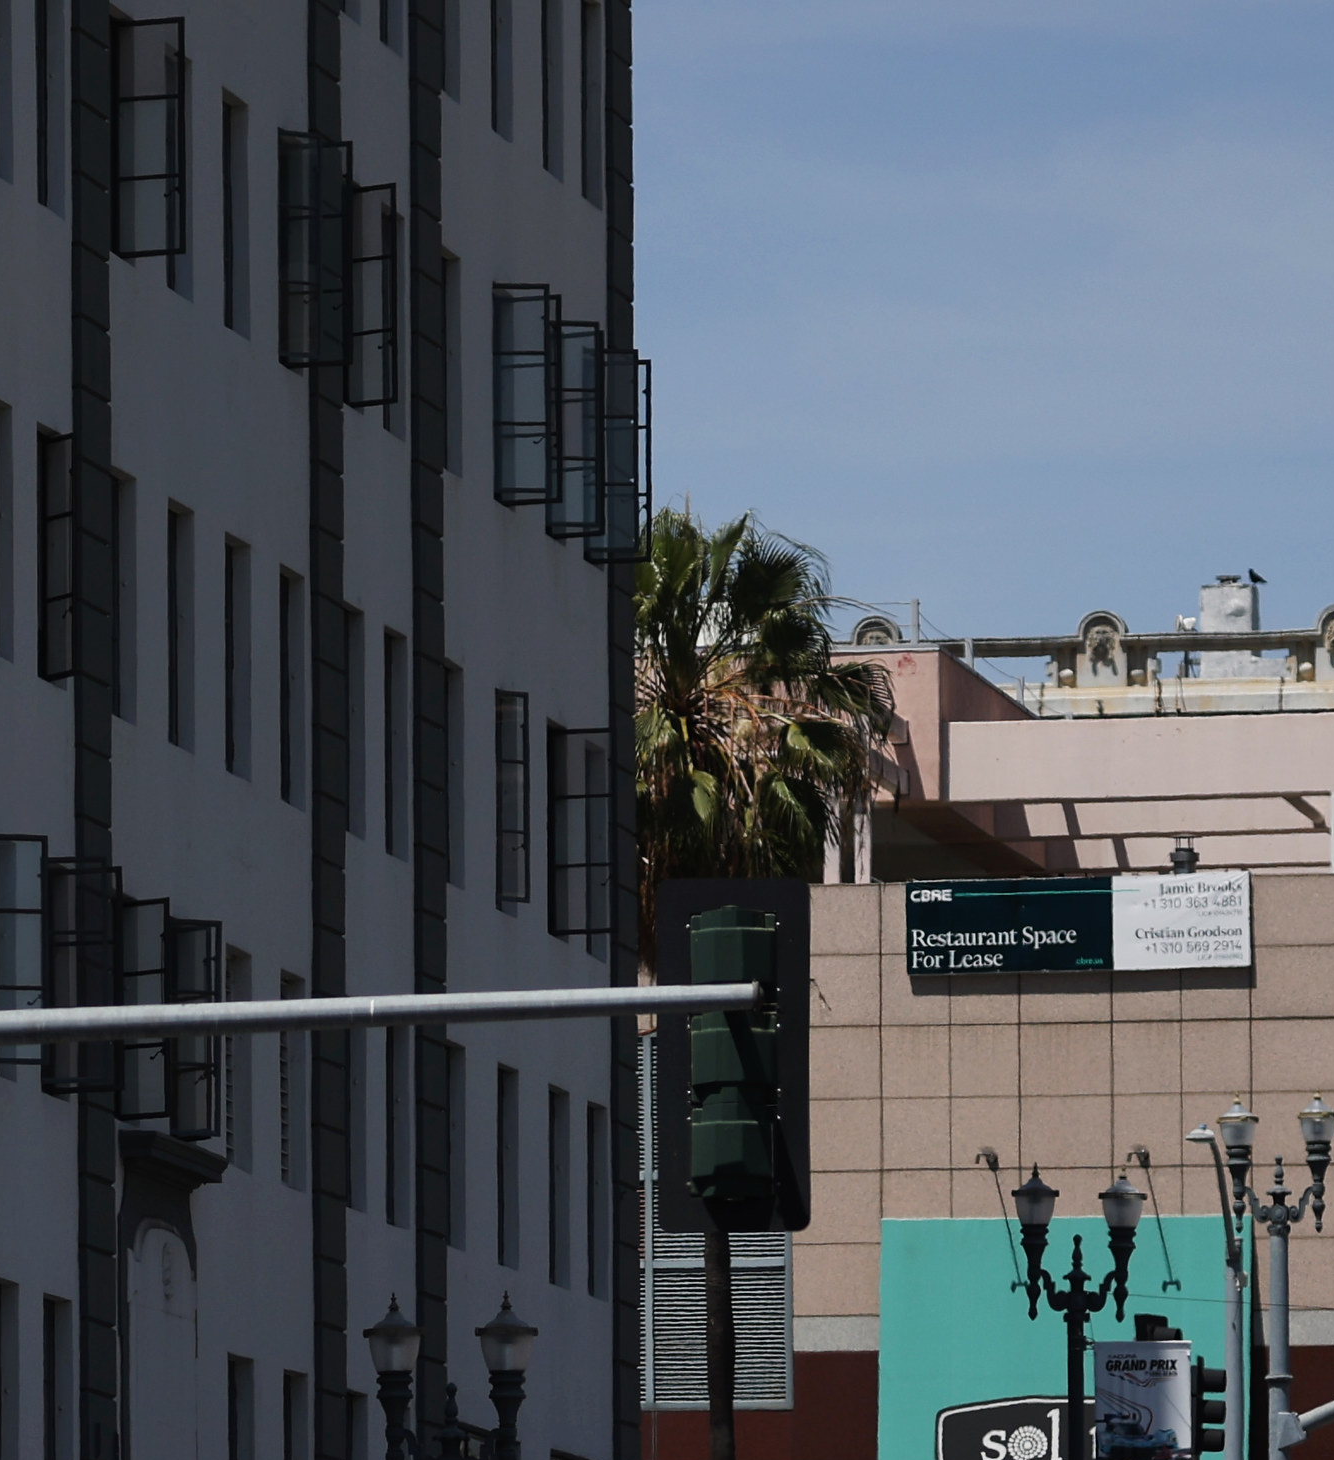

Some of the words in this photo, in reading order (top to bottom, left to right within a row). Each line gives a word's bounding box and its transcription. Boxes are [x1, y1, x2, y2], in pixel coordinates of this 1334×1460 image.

[910, 888, 953, 903] CBRE
[1160, 897, 1182, 909] 310
[911, 928, 1018, 948] Restaurant
[1022, 926, 1077, 950] Space
[1134, 926, 1185, 940] Cristian
[1187, 926, 1243, 938] Goodson
[1160, 942, 1183, 954] 310
[1214, 940, 1243, 951] 2914
[911, 950, 944, 969] For
[948, 950, 1003, 969] Lease
[1106, 1360, 1147, 1371] GRAND
[1150, 1359, 1178, 1370] PRIX
